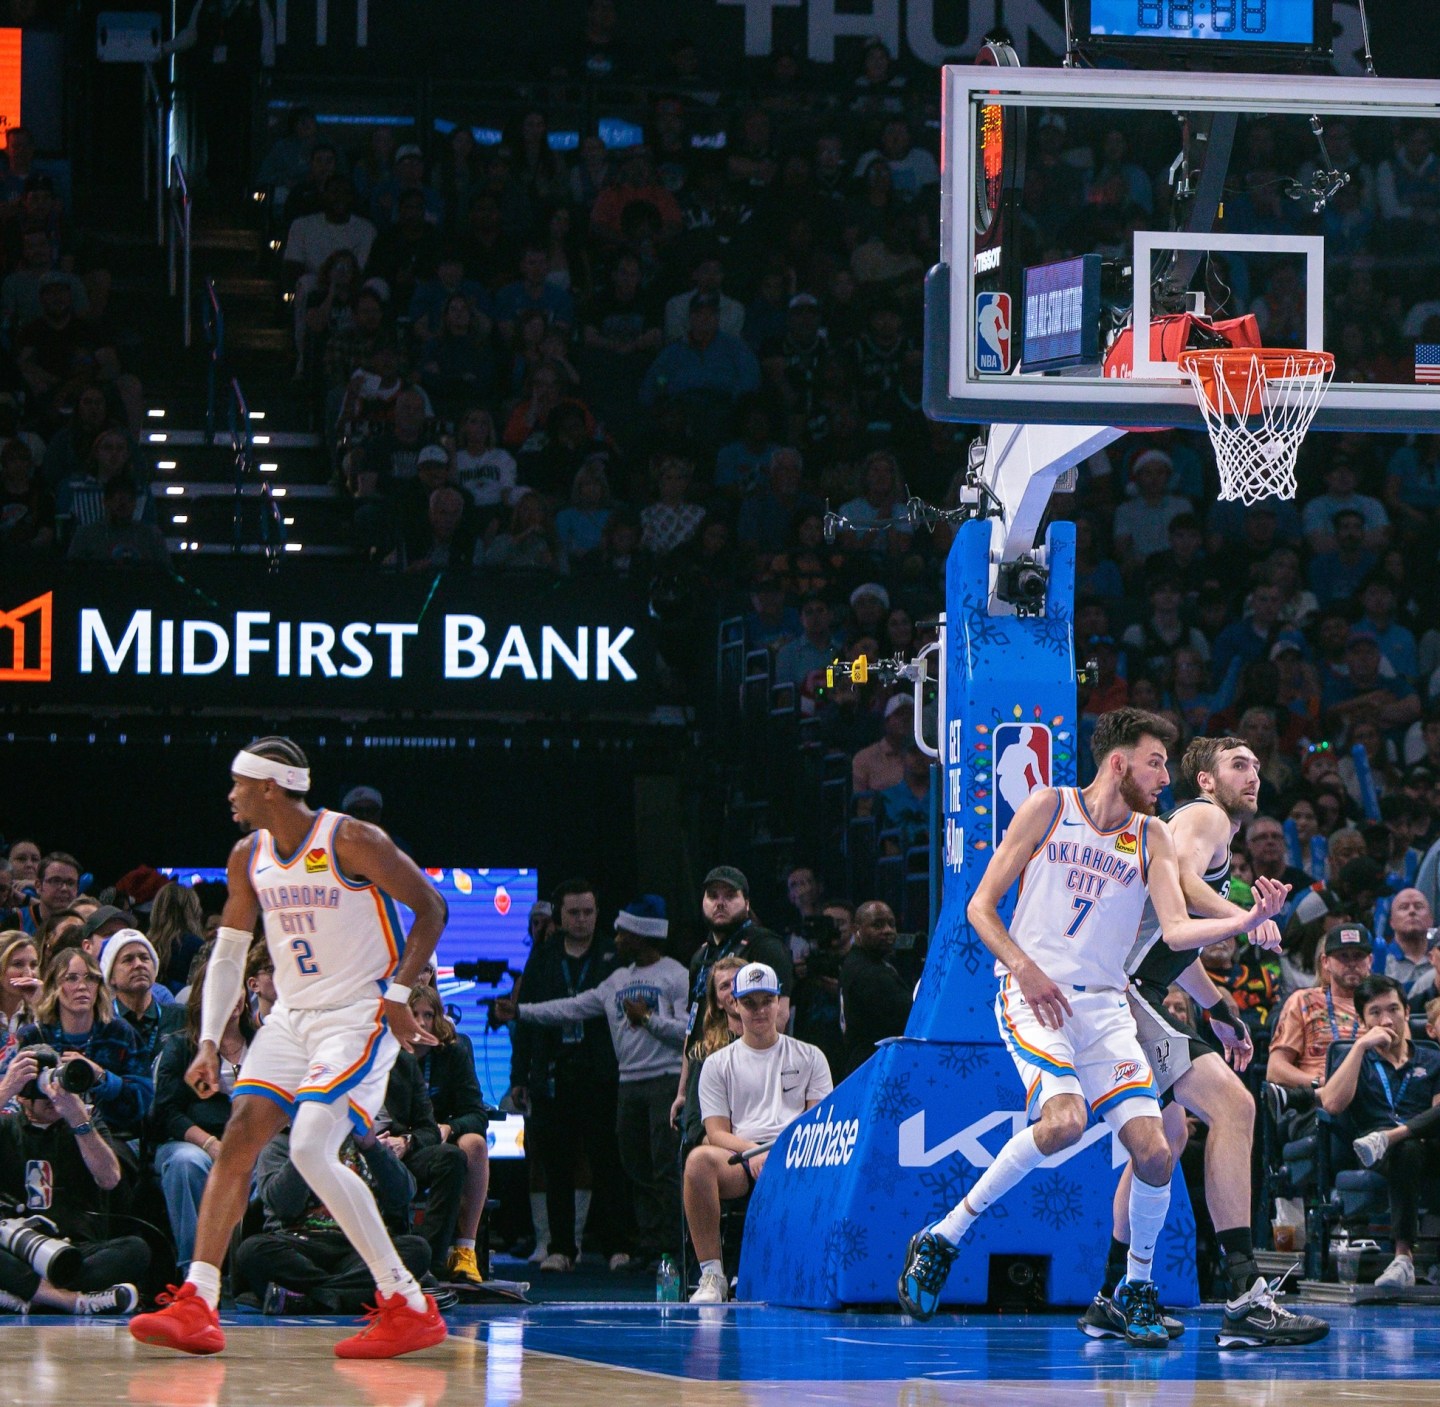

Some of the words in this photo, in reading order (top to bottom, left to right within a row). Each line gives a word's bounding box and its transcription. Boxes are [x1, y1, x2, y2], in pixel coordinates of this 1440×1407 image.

[975, 246, 1002, 274] TISSOT
[980, 354, 998, 368] NBA
[949, 718, 962, 765] GET
[949, 768, 962, 814] THE
[1046, 841, 1139, 888] OKLAHOMA
[1065, 868, 1108, 899] CITY
[258, 884, 340, 911] KLAHOMA
[1064, 895, 1095, 938] 7
[279, 910, 317, 934] CITY
[291, 937, 321, 976] 2
[785, 1105, 859, 1169] coinbase
